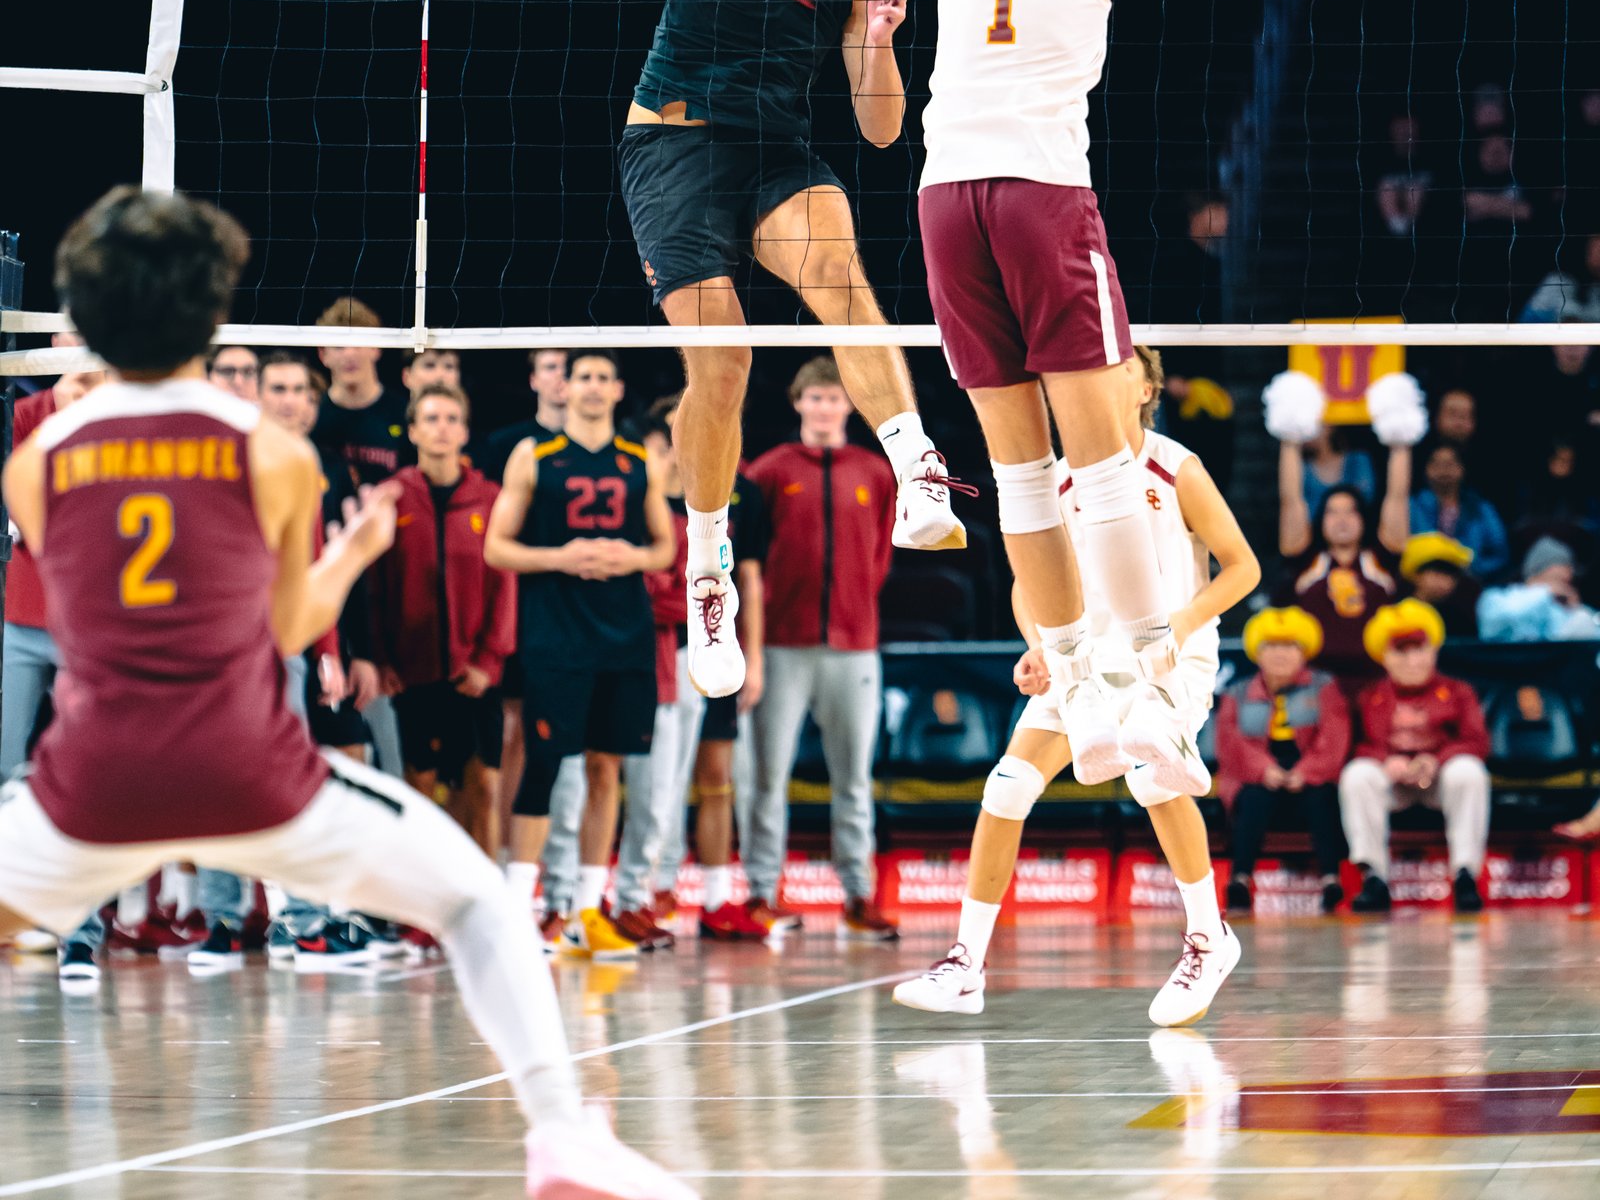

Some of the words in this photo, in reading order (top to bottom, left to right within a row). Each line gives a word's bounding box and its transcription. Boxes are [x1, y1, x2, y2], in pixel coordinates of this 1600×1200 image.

[53, 435, 241, 494] EMMANUEL
[564, 475, 627, 531] 23
[117, 491, 177, 609] 2
